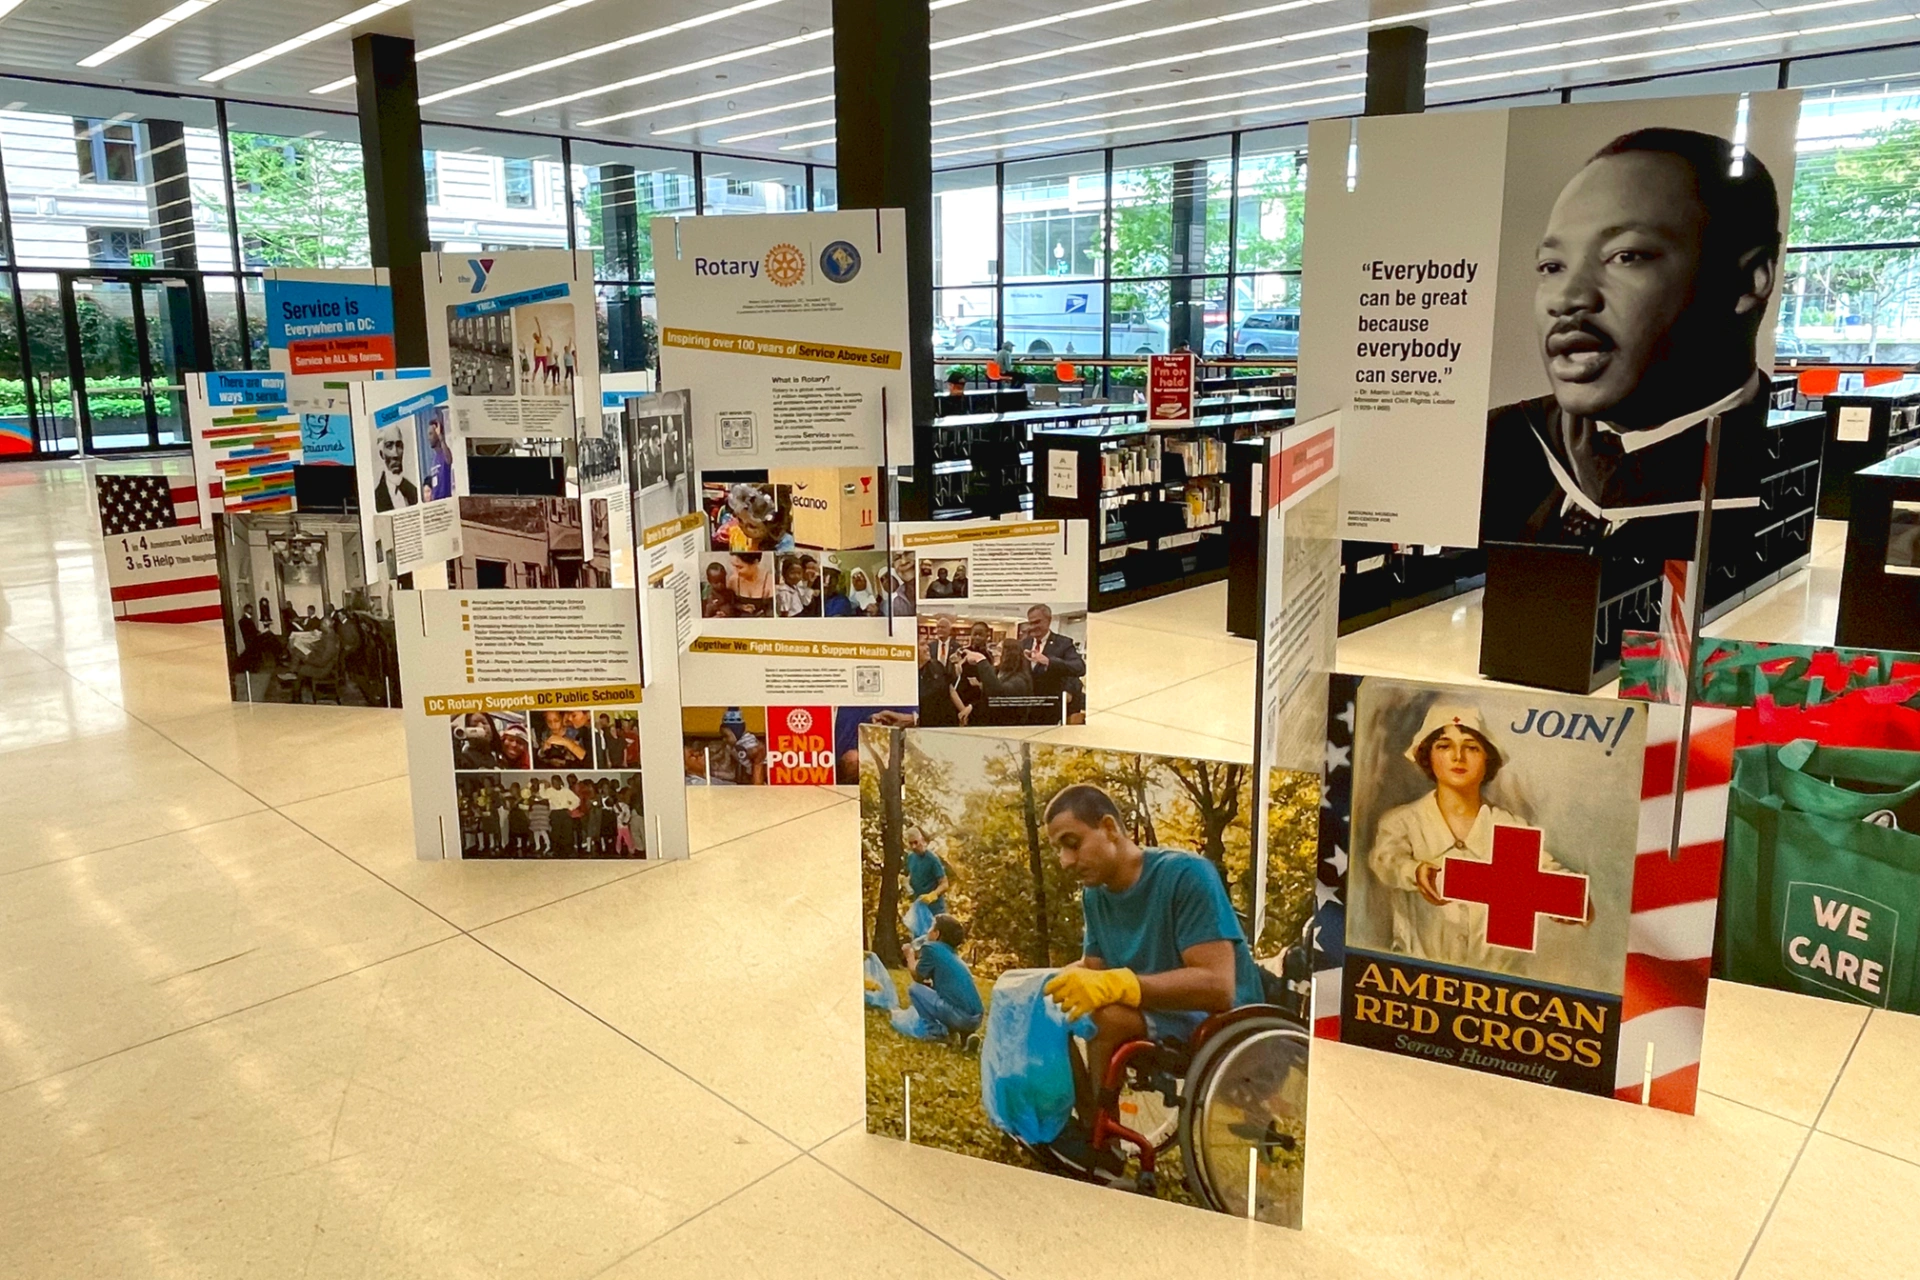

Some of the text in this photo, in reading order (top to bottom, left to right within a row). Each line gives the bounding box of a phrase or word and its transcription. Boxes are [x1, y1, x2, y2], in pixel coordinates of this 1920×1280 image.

[133, 253, 153, 267] EXIT
[695, 257, 759, 278] Rotary
[1362, 258, 1478, 284] “Everybody
[1359, 288, 1467, 309] can be great
[282, 297, 359, 320] Service is
[284, 318, 375, 337] Everywhere in DC:
[1358, 315, 1429, 332] because
[667, 331, 889, 365] Inspiring over 100 years of Service Above Self
[1357, 338, 1462, 362] everybody
[296, 356, 323, 366] Service
[333, 354, 347, 364] ALL
[772, 376, 791, 384] What
[801, 375, 830, 384] Rotary?
[1154, 366, 1187, 376] I'm on
[1355, 367, 1452, 383] can serve.”
[218, 375, 284, 391] There are many
[1160, 377, 1184, 387] hold
[219, 391, 243, 405] ways
[245, 390, 254, 401] to
[803, 431, 830, 439] Service
[793, 495, 828, 510] ecanoo
[121, 538, 129, 552] 1
[139, 535, 148, 550] 4
[125, 556, 135, 570] 3
[143, 554, 152, 568] 5
[152, 554, 174, 568] Help
[694, 639, 912, 658] Together We Fight Disease & Support Health Care
[429, 688, 635, 712] DC Rotary Supports DC Public Schools
[1511, 706, 1635, 756] JOIN!
[778, 735, 825, 752] END
[768, 751, 834, 768] POLIO
[776, 768, 829, 784] NOW
[1813, 895, 1872, 941] WE
[1788, 936, 1884, 994] CARE
[1356, 962, 1607, 1035] AMERICAN
[1355, 994, 1602, 1068] RED CROSS
[1395, 1034, 1558, 1083] Serves Humanity
